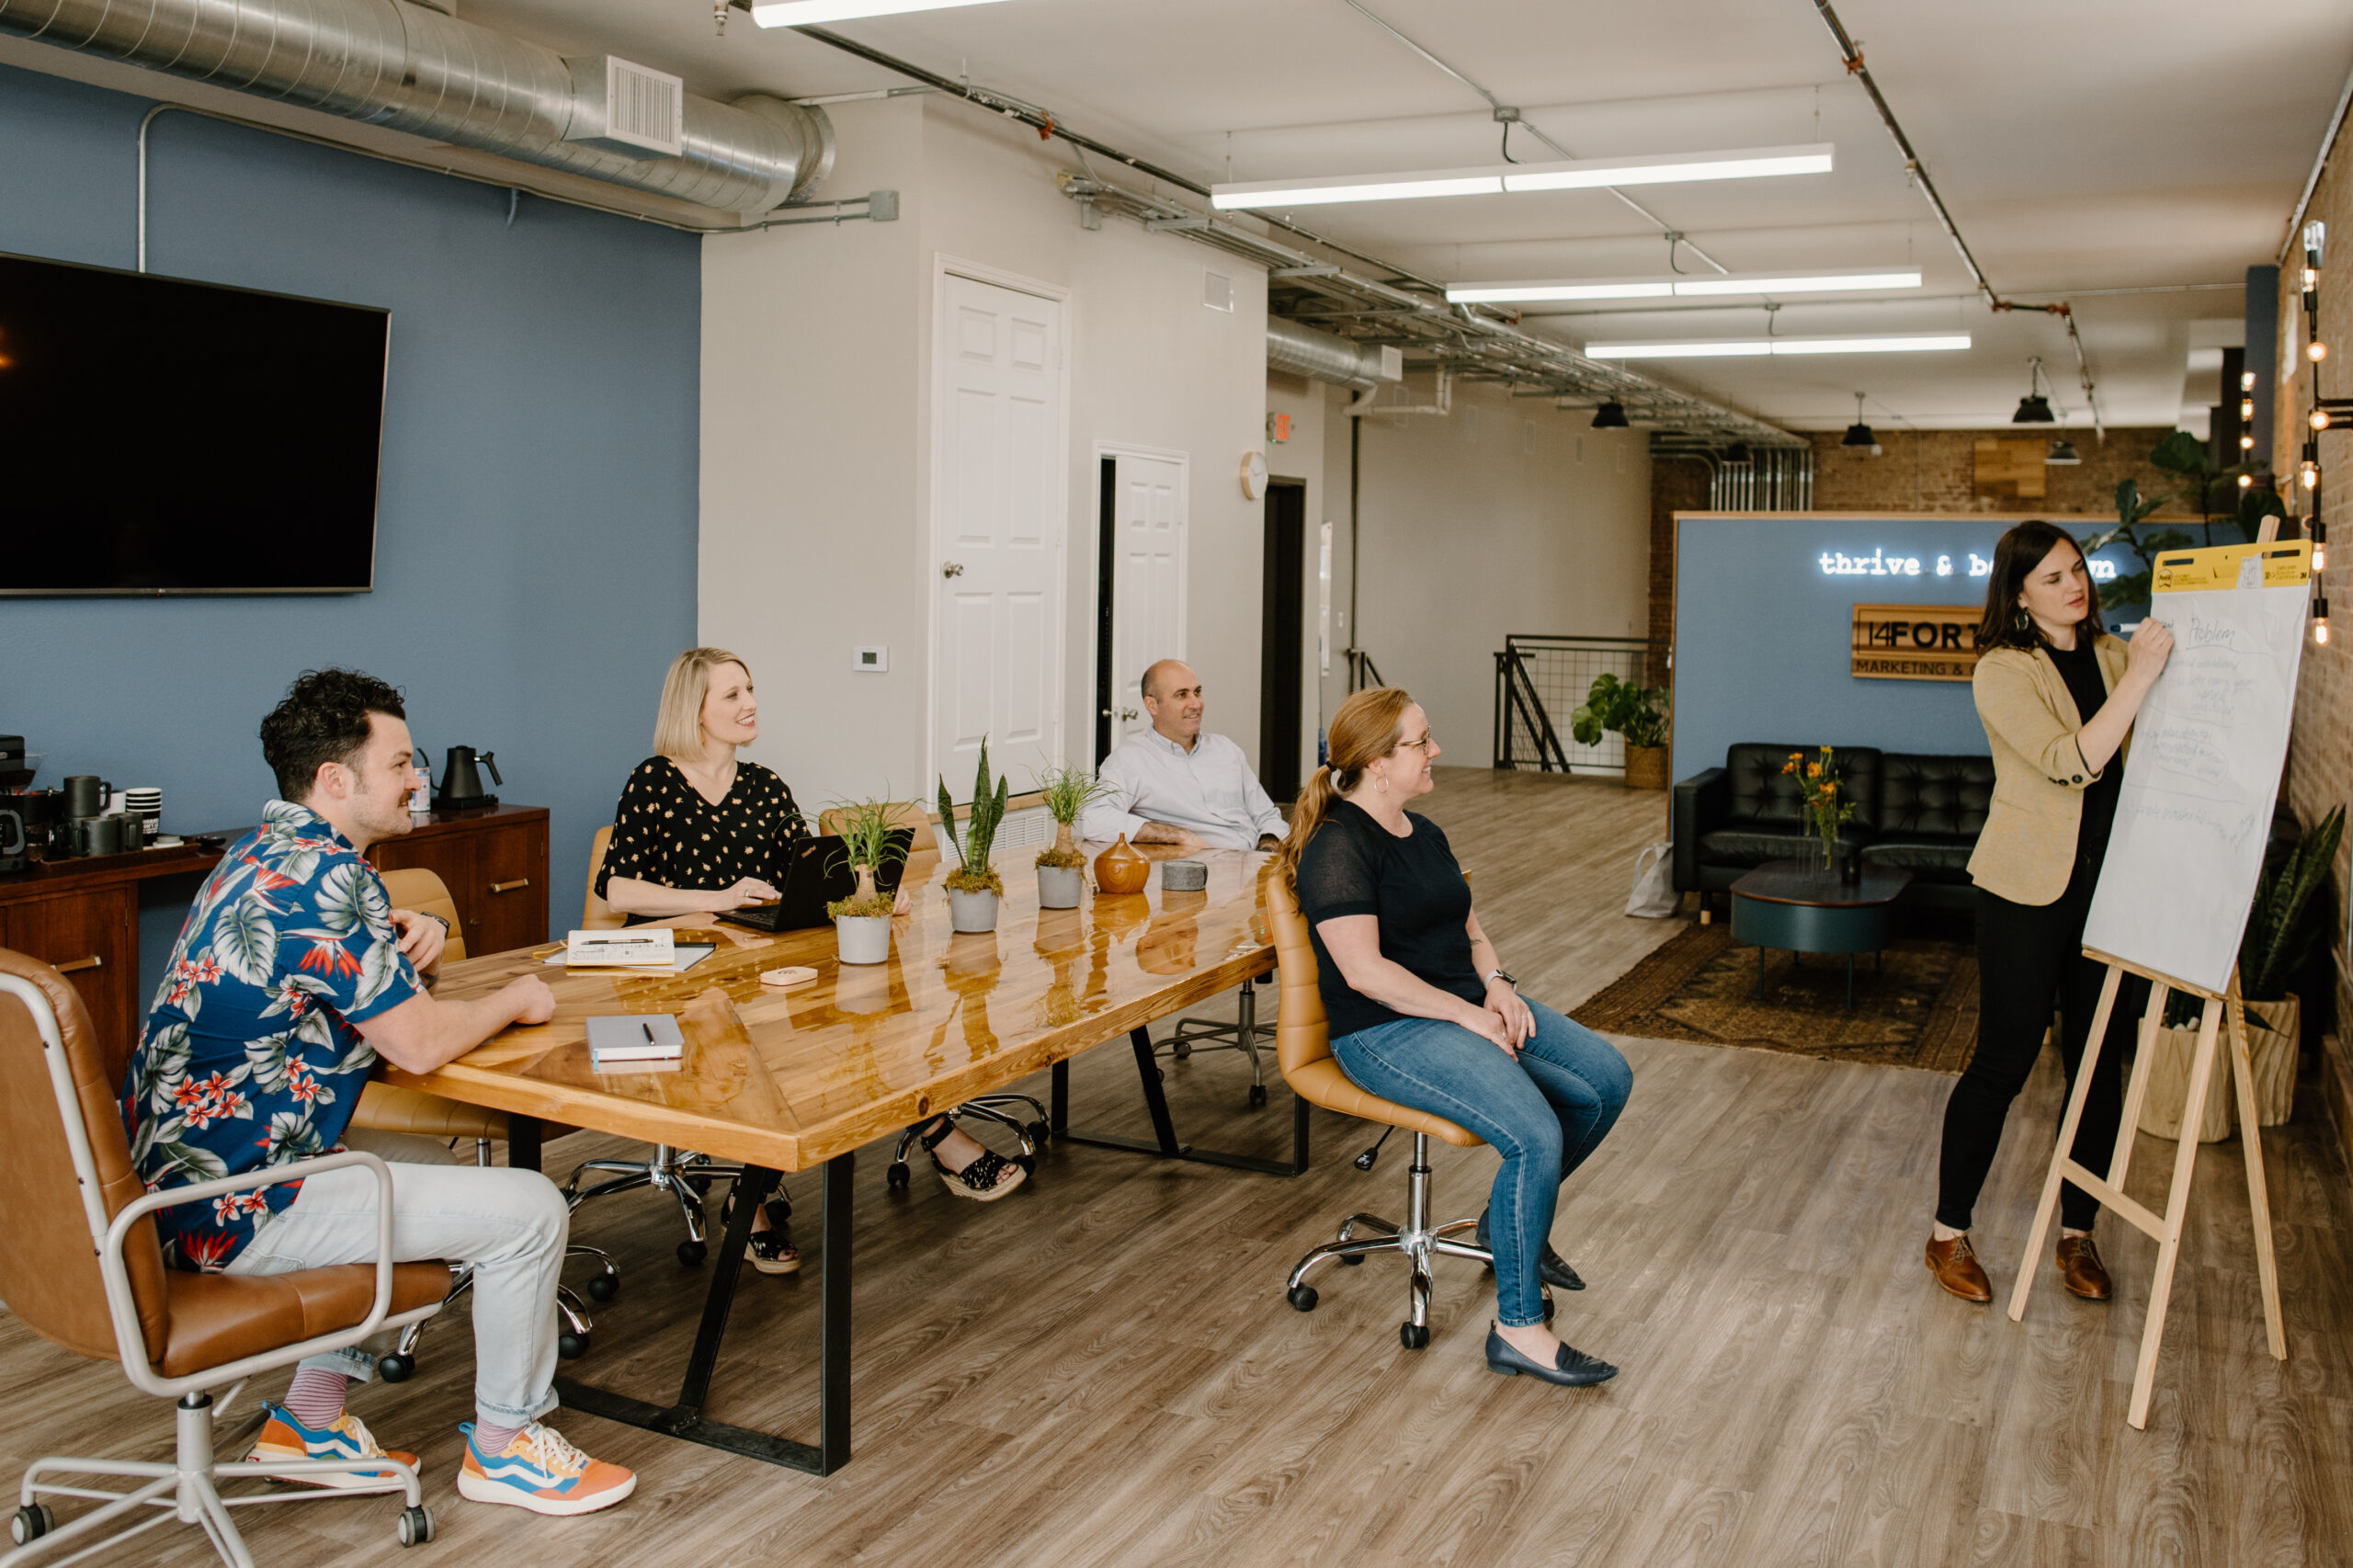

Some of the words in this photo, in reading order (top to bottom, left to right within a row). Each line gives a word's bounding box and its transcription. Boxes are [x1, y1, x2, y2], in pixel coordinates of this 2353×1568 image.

[1819, 548, 1920, 575] thrive
[1936, 555, 1952, 576] &
[2188, 617, 2235, 646] Problem
[1857, 660, 1946, 675] MARKETING
[1952, 663, 1963, 676] &
